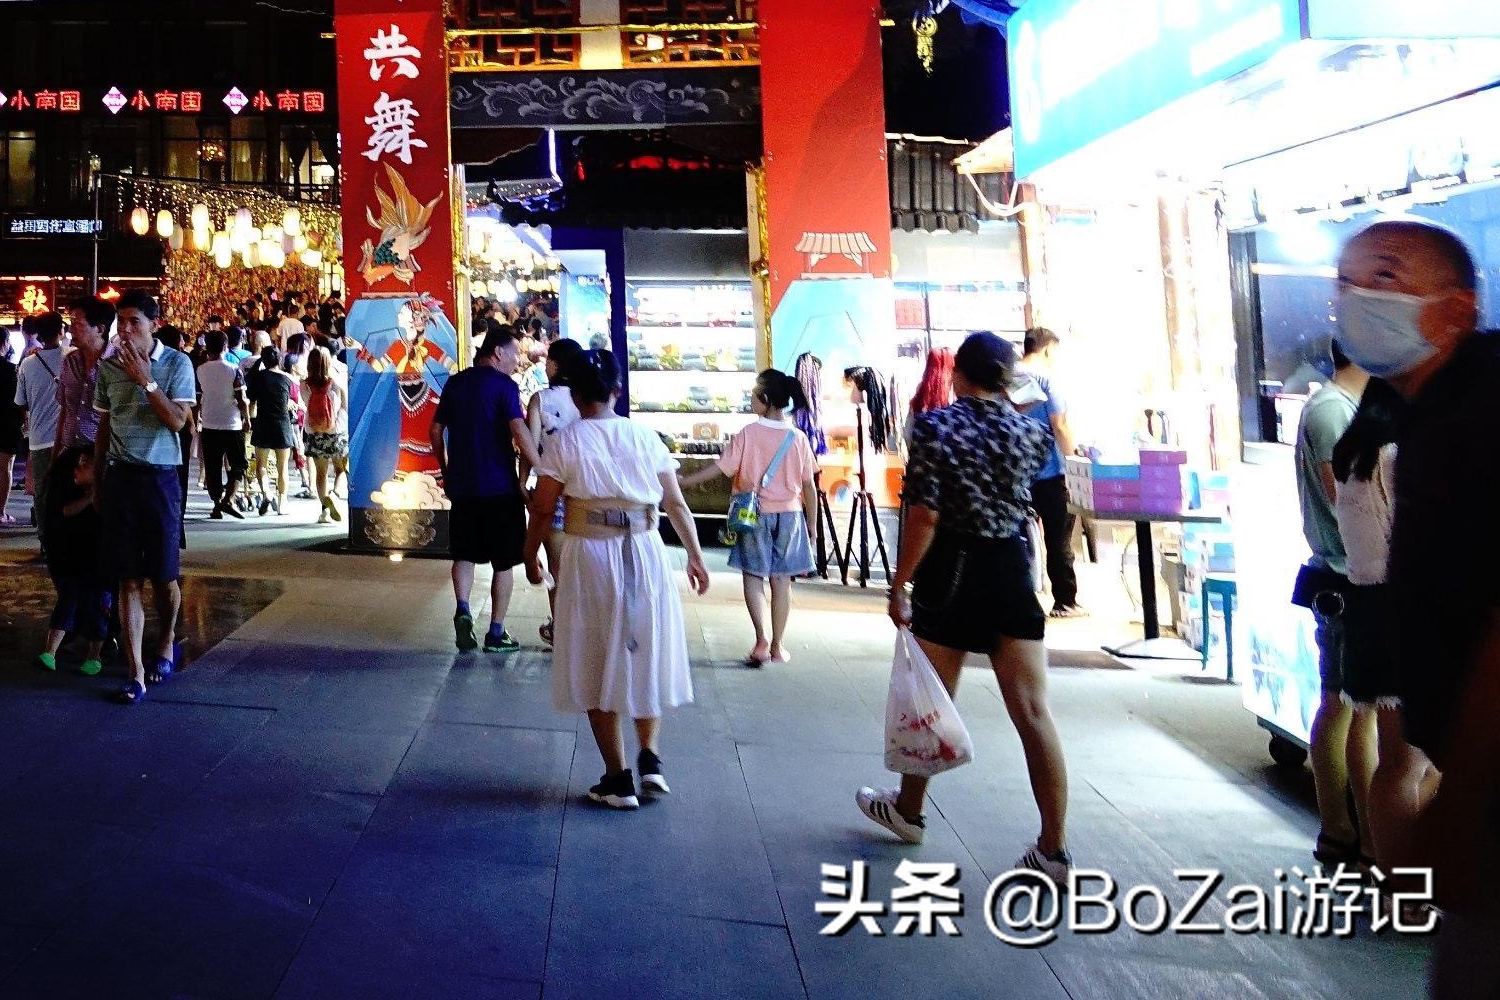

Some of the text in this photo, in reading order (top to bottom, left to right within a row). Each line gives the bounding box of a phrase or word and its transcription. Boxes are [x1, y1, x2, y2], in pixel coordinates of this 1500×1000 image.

[10, 89, 81, 112] 小南国
[130, 89, 202, 112] 小南国
[253, 89, 325, 113] 小南国
